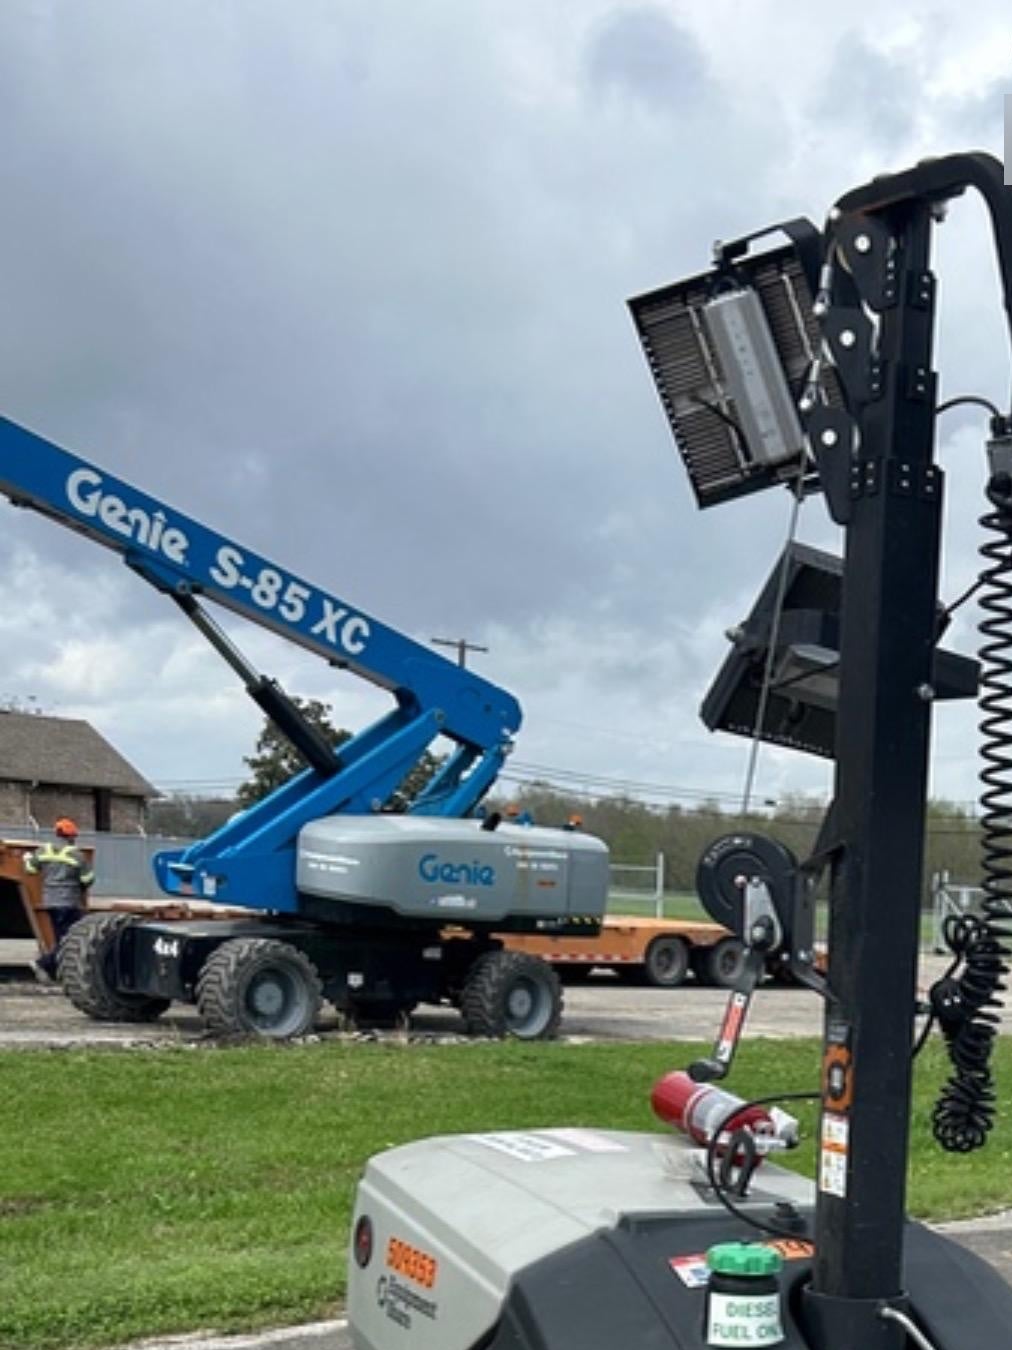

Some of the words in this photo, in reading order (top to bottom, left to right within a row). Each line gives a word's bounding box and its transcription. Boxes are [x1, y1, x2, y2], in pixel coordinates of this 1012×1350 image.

[65, 467, 190, 566] Genie
[209, 546, 310, 622] S-85
[311, 599, 371, 655] XC
[418, 853, 496, 886] Genie
[713, 1322, 752, 1339] FUEL
